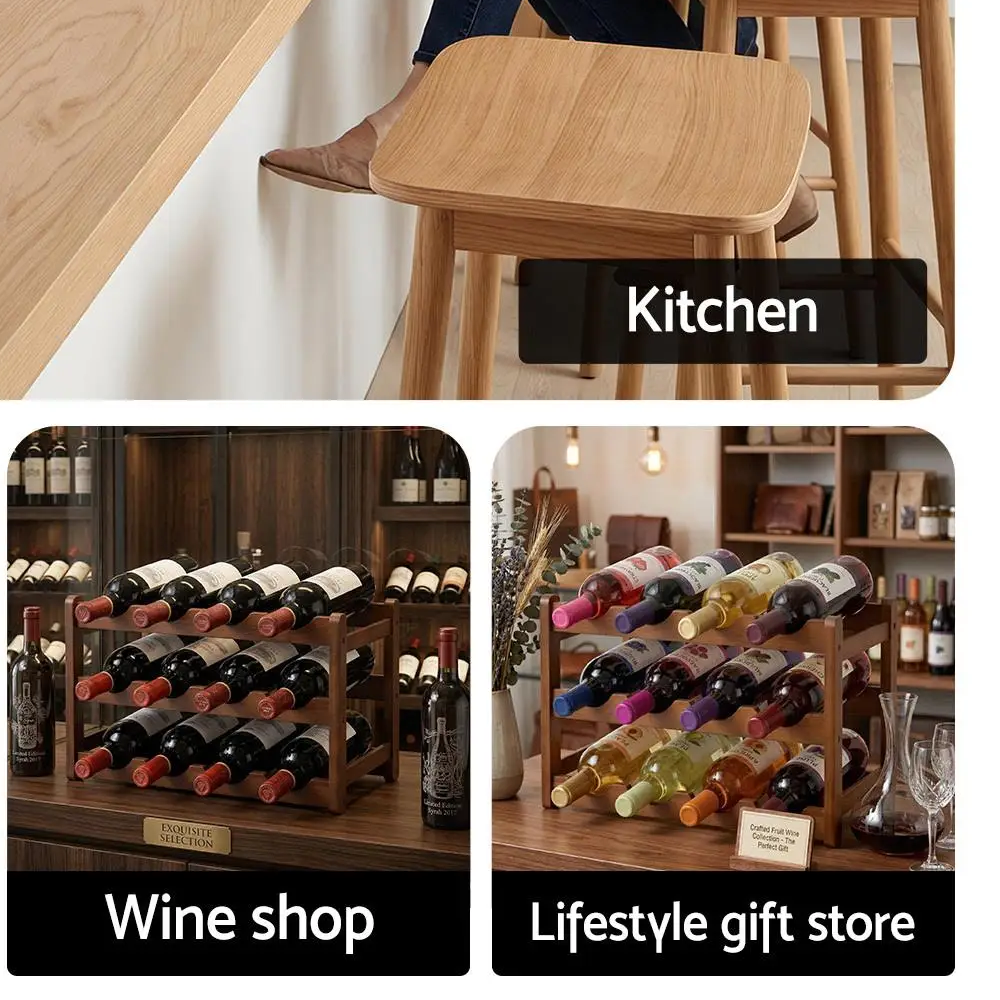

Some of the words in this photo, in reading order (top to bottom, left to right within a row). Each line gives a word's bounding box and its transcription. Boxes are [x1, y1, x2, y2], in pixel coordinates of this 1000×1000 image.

[161, 823, 212, 838] EXQUISITE
[750, 823, 770, 834] Crafted
[771, 826, 785, 836] Fruit
[785, 828, 800, 838] Wine
[160, 833, 213, 848] SELECTION
[752, 832, 780, 843] Collection
[785, 836, 796, 845] The
[757, 841, 778, 851] Perfect
[778, 843, 789, 853] Gift
